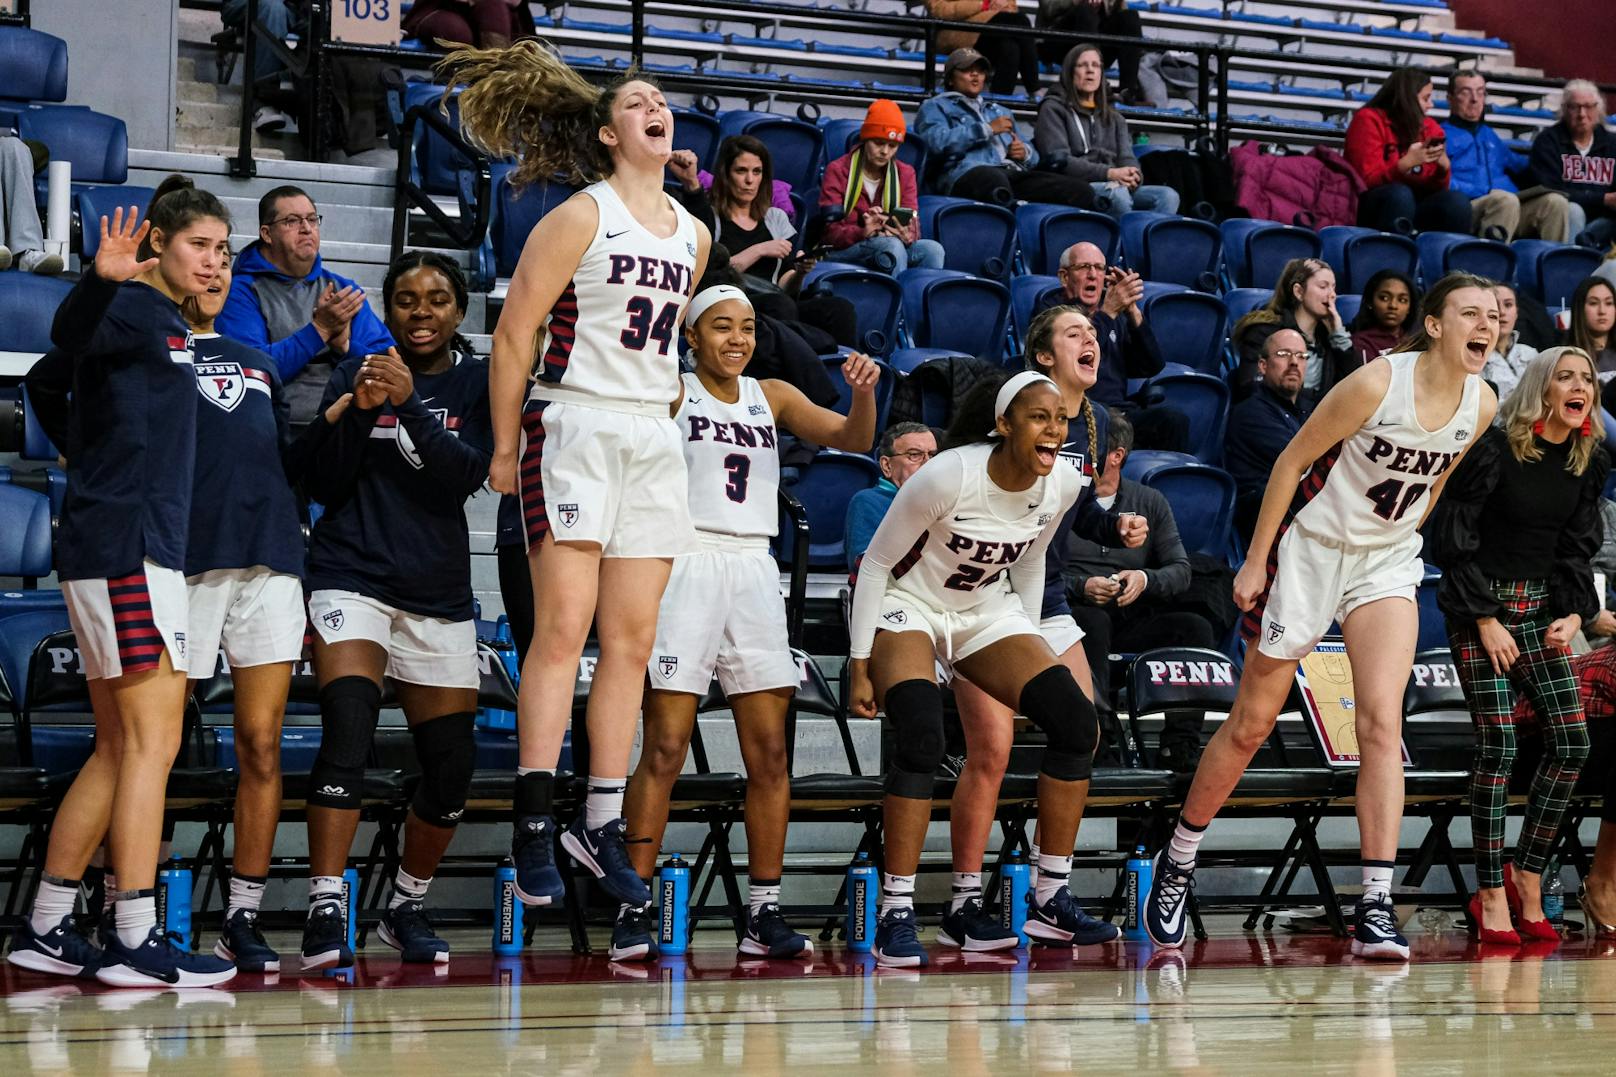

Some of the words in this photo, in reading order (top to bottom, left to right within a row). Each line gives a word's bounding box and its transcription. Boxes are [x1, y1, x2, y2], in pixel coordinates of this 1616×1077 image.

[341, 0, 390, 21] 103
[1561, 153, 1616, 186] PENN
[620, 295, 680, 356] 34
[196, 365, 237, 374] PENN
[688, 415, 775, 450] PENN
[1364, 435, 1460, 477] PENN
[723, 452, 751, 504] 3
[1146, 660, 1235, 686] PENN
[1412, 663, 1461, 687] PE
[340, 883, 349, 942] POWE
[501, 881, 513, 942] POWERADE
[663, 881, 674, 941] POWERADE
[855, 881, 865, 940] POWERADE
[1002, 878, 1011, 929] OWERADE
[1128, 871, 1137, 928] POWERADE
